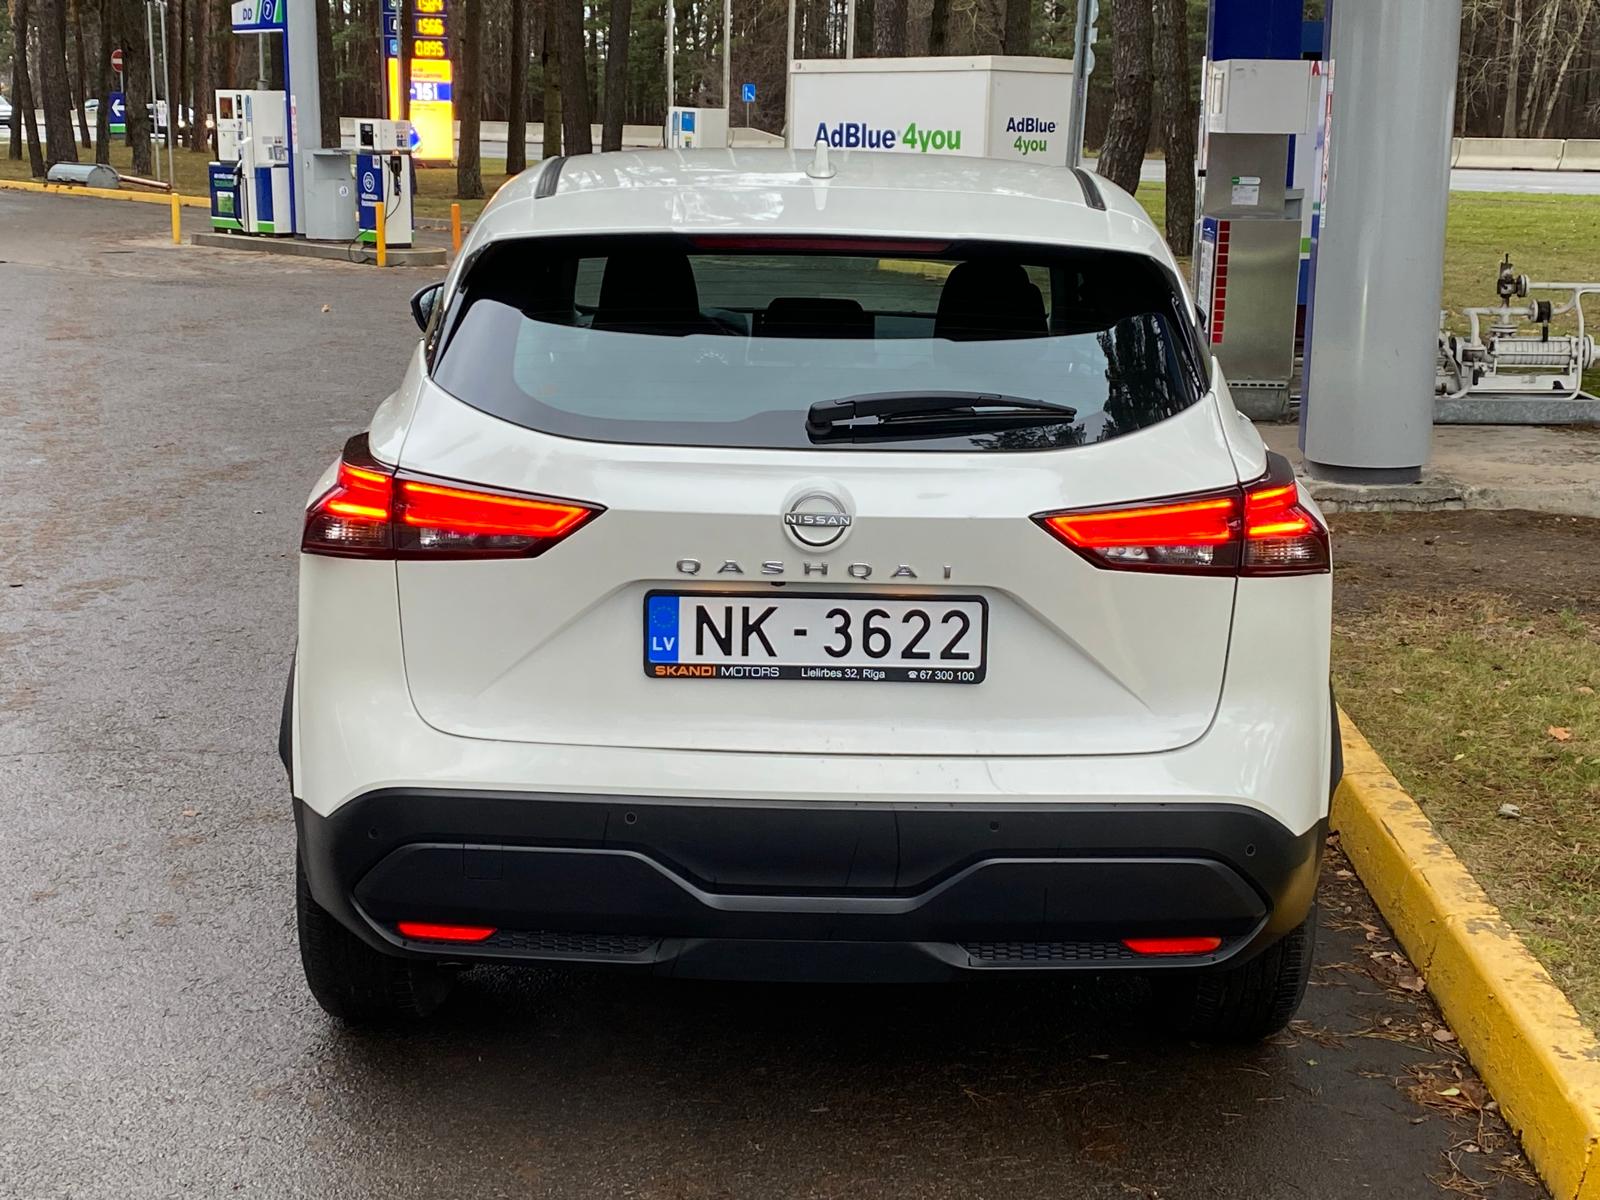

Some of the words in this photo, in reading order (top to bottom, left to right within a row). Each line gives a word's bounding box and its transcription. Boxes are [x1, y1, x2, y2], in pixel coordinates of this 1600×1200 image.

[1006, 117, 1056, 133] AdBlue
[815, 122, 896, 149] AdBlue
[902, 122, 961, 152] 4you
[1013, 136, 1047, 156] 4you
[786, 514, 851, 526] NISSAN
[676, 559, 952, 581] QASHQAI
[652, 637, 675, 651] LV
[655, 665, 716, 676] SKANDI
[721, 666, 780, 677] MOTORS
[844, 668, 860, 680] 32,
[919, 670, 933, 680] 67
[935, 670, 954, 681] 300
[956, 671, 975, 682] 100
